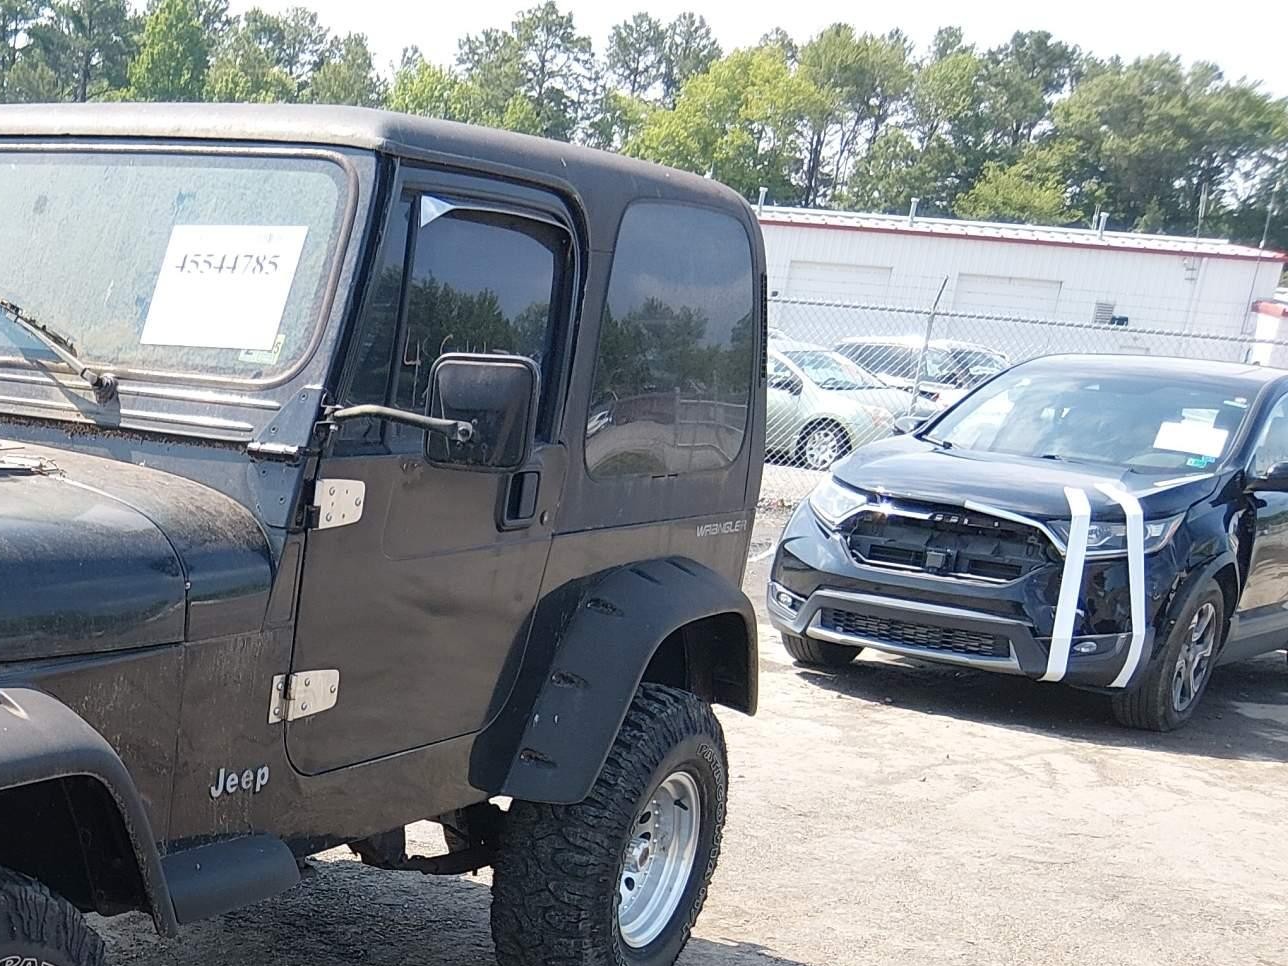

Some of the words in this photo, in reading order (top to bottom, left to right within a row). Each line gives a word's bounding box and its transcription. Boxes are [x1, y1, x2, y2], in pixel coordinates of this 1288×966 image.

[176, 254, 280, 275] 45544785
[696, 519, 747, 537] WRANGLER
[210, 766, 269, 798] Jeep
